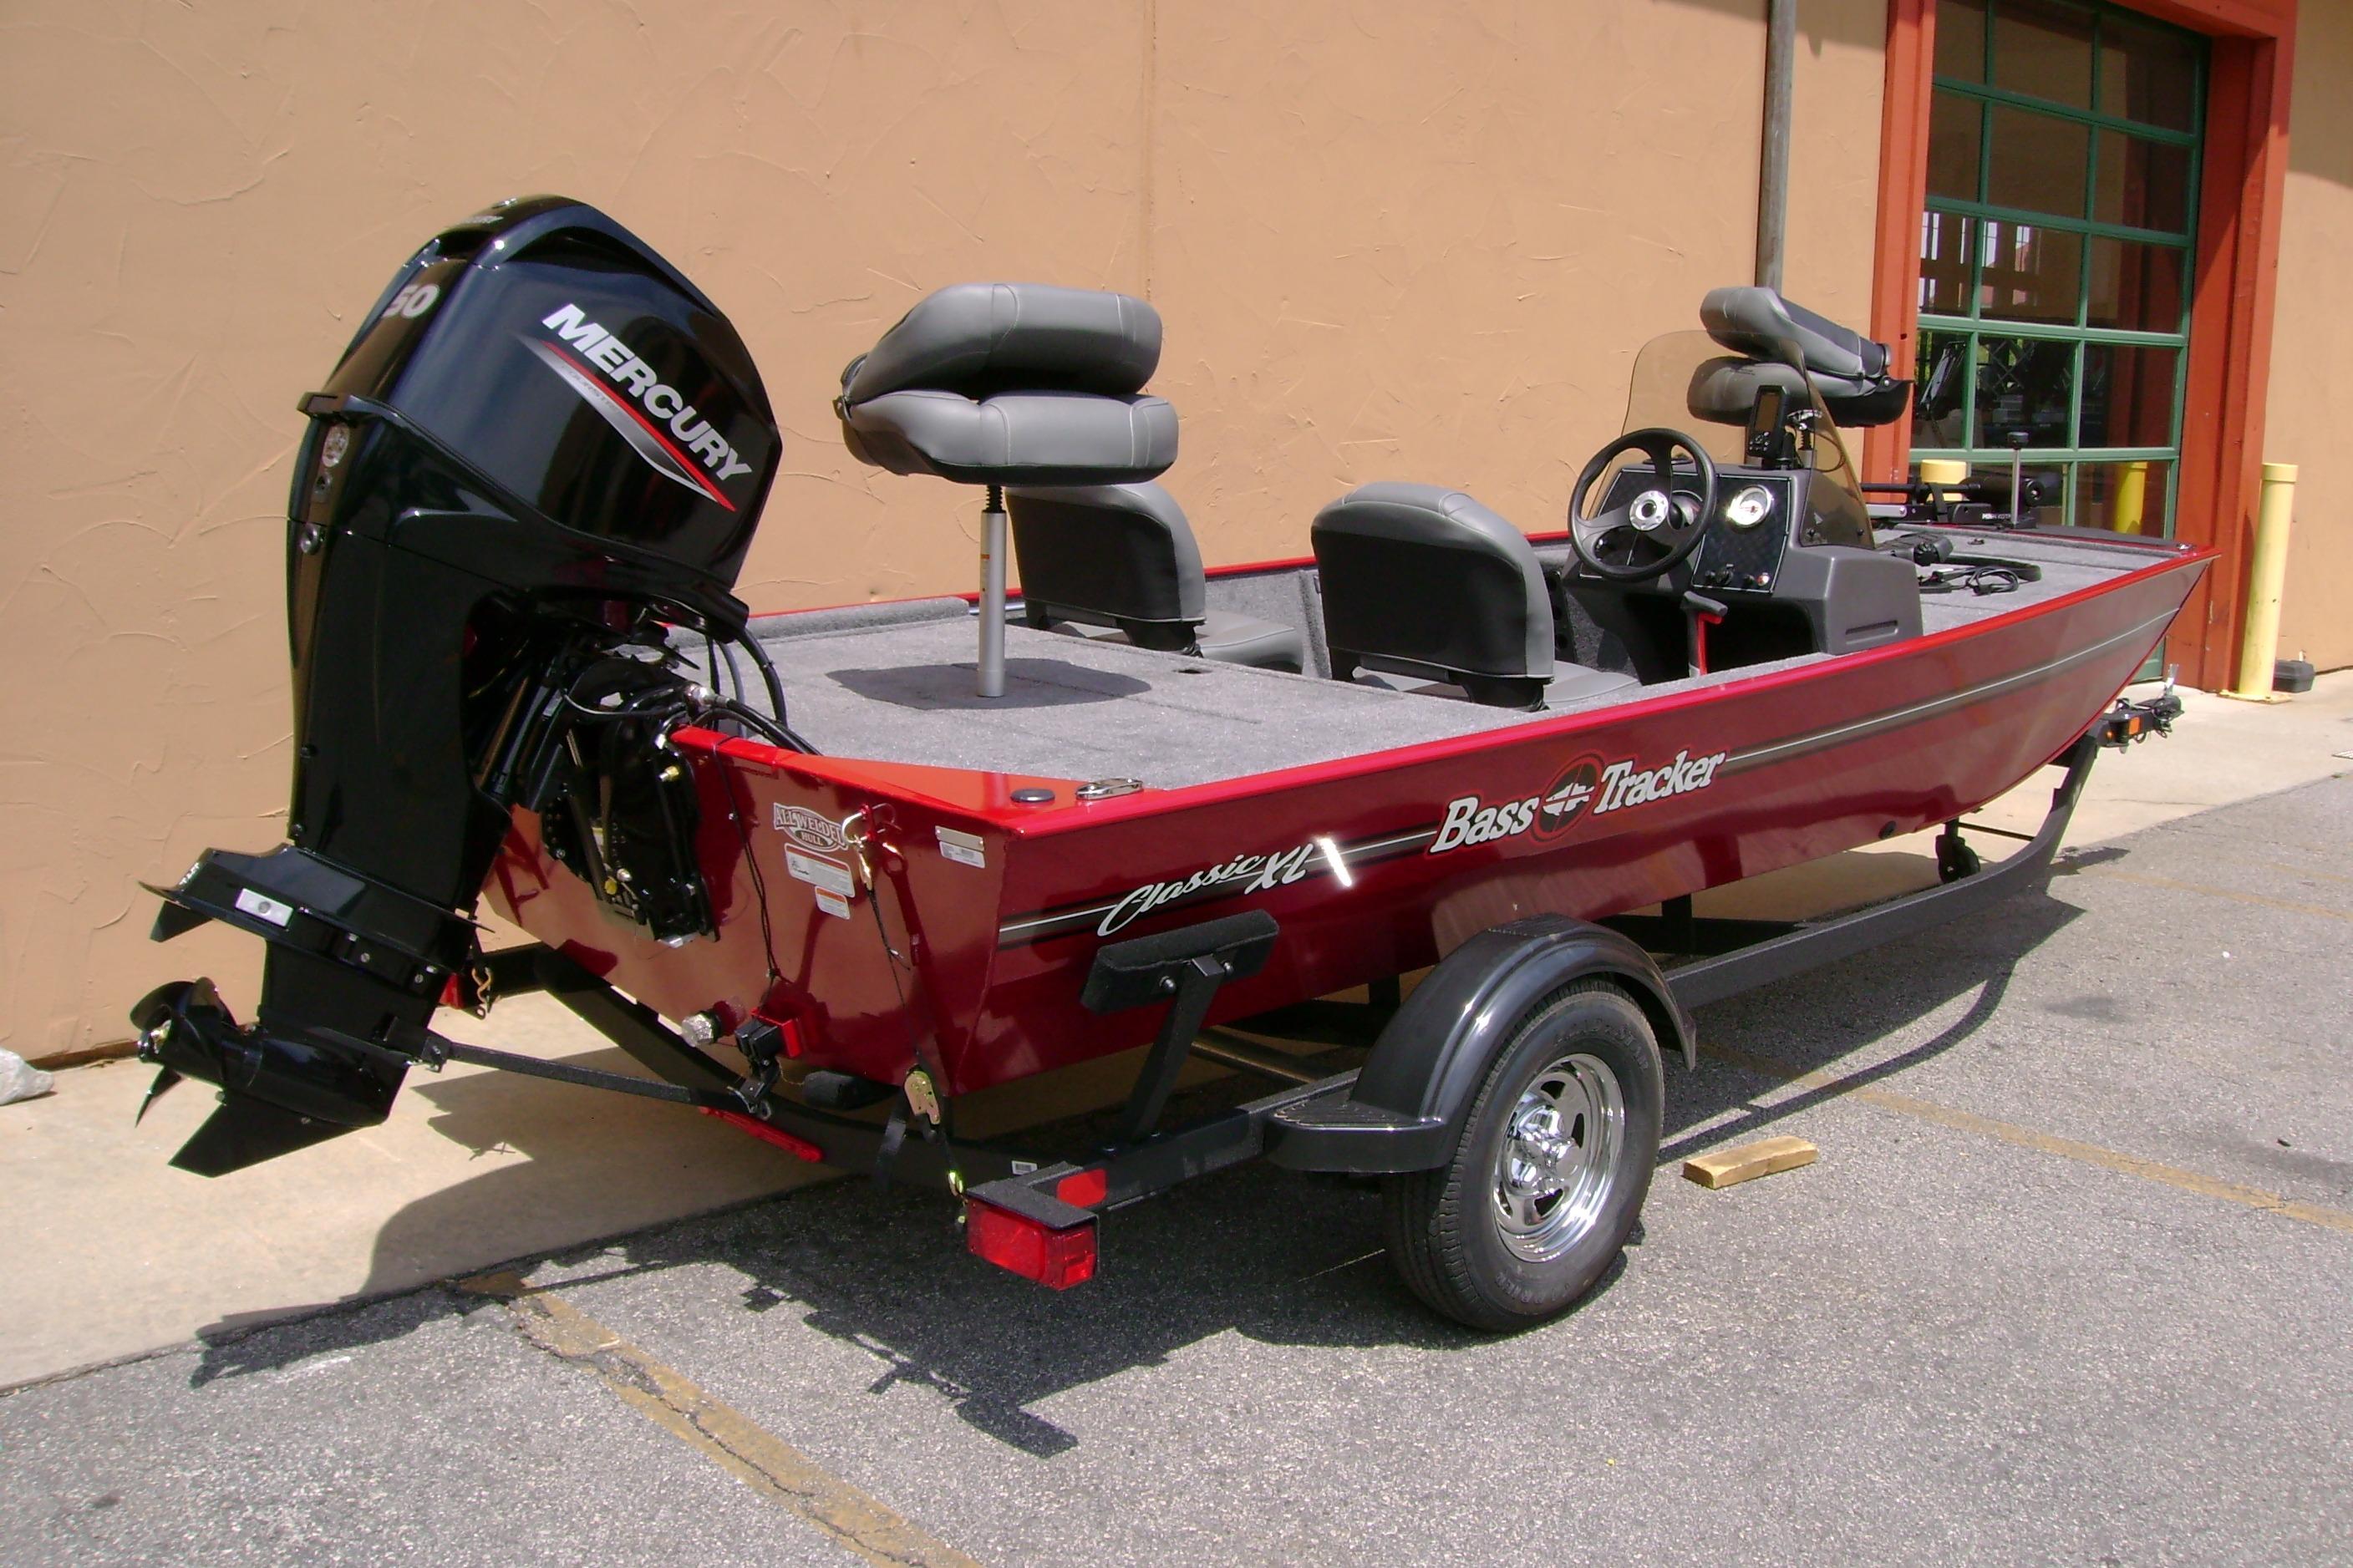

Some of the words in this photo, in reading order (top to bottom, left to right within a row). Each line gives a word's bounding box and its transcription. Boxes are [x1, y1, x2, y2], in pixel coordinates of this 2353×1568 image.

[382, 283, 440, 318] 50
[541, 302, 752, 481] MERCURY
[775, 807, 796, 825] ALL
[1430, 796, 1540, 853] Bass
[1593, 749, 1726, 814] Tracker
[800, 831, 824, 846] HULL
[1097, 854, 1267, 936] Classic
